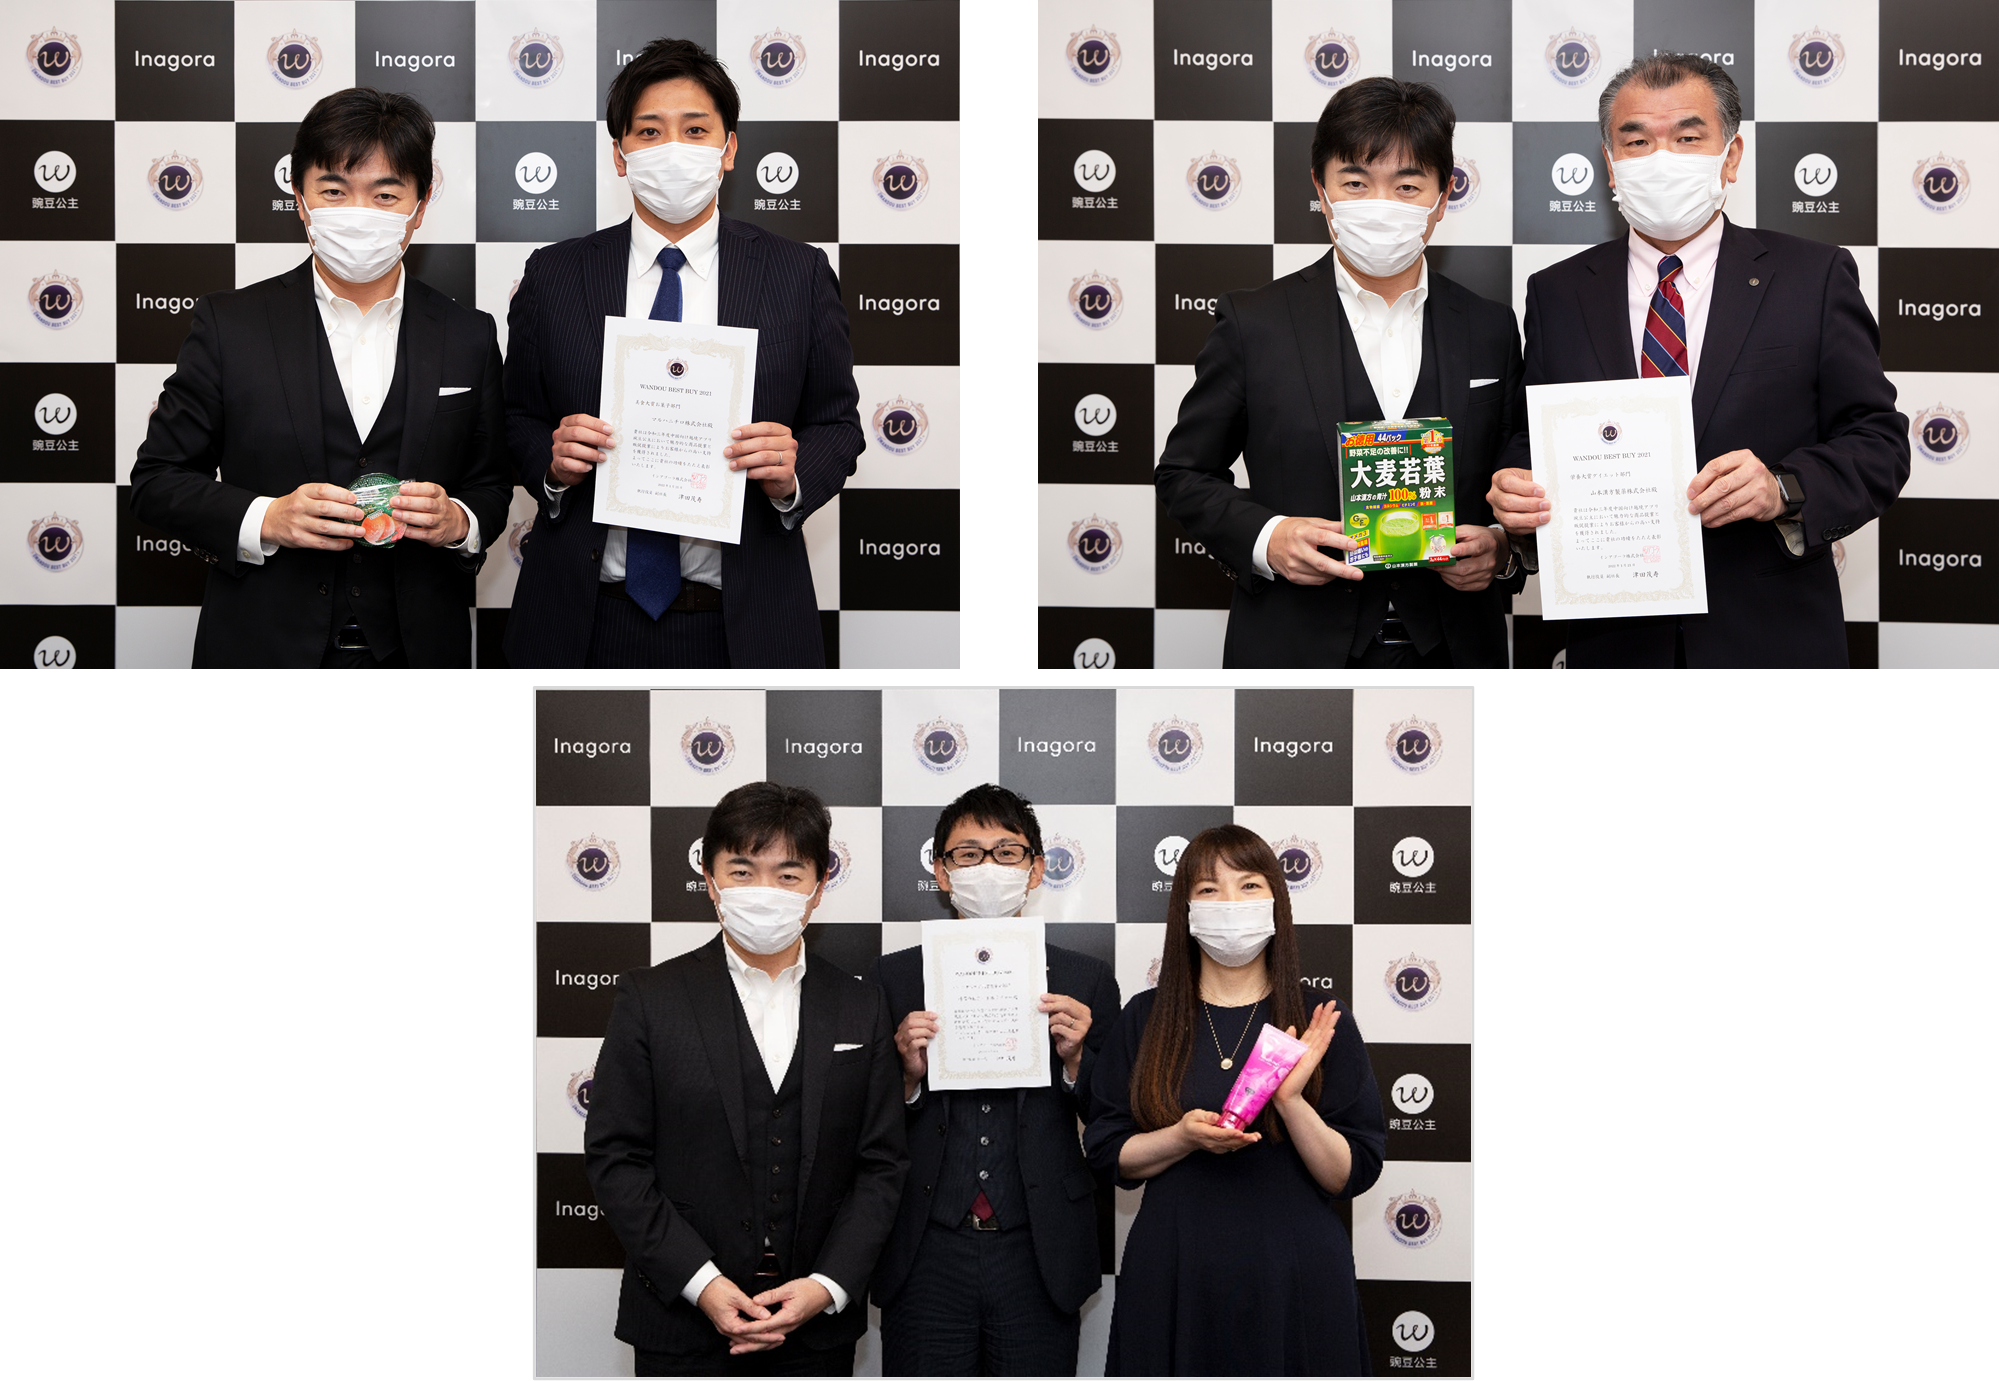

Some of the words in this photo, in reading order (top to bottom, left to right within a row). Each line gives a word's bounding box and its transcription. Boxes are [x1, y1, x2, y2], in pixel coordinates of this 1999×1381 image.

[136, 51, 215, 72] Inagora
[376, 51, 455, 72] Inagora
[860, 50, 940, 71] Inagora
[1174, 49, 1253, 70] Inagora
[1413, 50, 1492, 71] Inagora
[1900, 49, 1982, 71] Inagora
[32, 198, 79, 209] 豌豆公主
[272, 199, 299, 211] 豌豆
[513, 199, 560, 211] 豌豆公主
[754, 199, 801, 211] 豌豆公主
[1072, 197, 1119, 209] 豌豆公主
[1550, 201, 1597, 213] 豌豆公主
[1792, 201, 1840, 214] 豌豆公主
[136, 293, 198, 314] Inago
[860, 295, 940, 316] Inagora
[1175, 294, 1218, 316] Inag
[1899, 299, 1982, 321] Inagora
[640, 384, 667, 392] WANDOU
[32, 440, 79, 452] 豌豆公主
[1072, 441, 1119, 453] 豌豆公主
[1345, 433, 1375, 447] お徳用
[1377, 433, 1402, 442] 44パック
[1572, 454, 1602, 462] WANDOU
[1350, 456, 1446, 489] 大麦若葉
[1388, 488, 1417, 502] 100%
[1419, 486, 1446, 499] 粉末
[136, 535, 191, 556] Inag
[860, 539, 940, 560] Inagora
[1900, 549, 1982, 571] Inagora
[554, 738, 631, 758] Inagora
[785, 739, 863, 759] Inagora
[1018, 737, 1096, 757] Inagora
[1254, 737, 1333, 758] Inagora
[1389, 881, 1437, 894] 豌豆公主
[556, 969, 620, 990] Inagor
[1389, 1119, 1437, 1131] 豌豆公主
[556, 1200, 605, 1221] Inag
[1390, 1356, 1438, 1369] 豌豆公主
